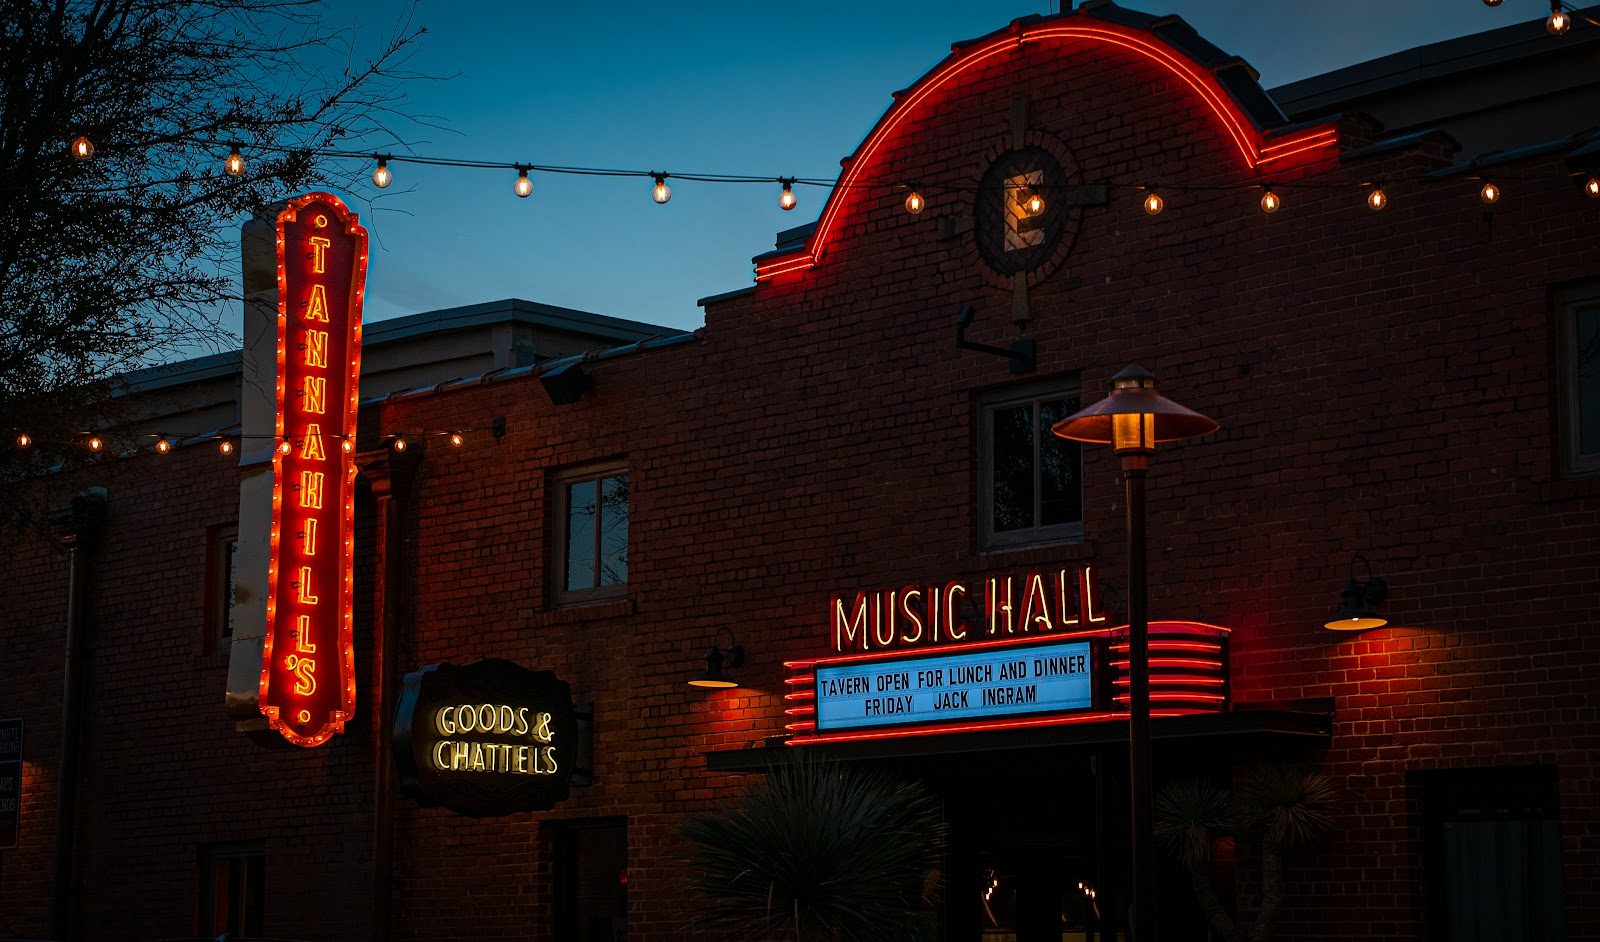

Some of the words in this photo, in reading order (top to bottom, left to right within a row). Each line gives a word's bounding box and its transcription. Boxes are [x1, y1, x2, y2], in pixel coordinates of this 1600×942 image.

[285, 236, 331, 696] TANNAHILL'S
[833, 582, 966, 651] MUSIC
[987, 566, 1106, 634] HALL
[821, 676, 870, 697] TAVERN
[877, 672, 909, 692] OPEN
[918, 669, 943, 689] FOR
[949, 664, 992, 686] LUNCH
[1000, 661, 1027, 681] AND
[1034, 655, 1085, 678] DINNER
[865, 695, 913, 716] FRIDAY
[934, 690, 969, 710] JACK
[982, 685, 1036, 706] INGRAM
[437, 704, 529, 736] GOODS
[535, 712, 555, 743] &
[434, 741, 558, 775] CHATTELS
